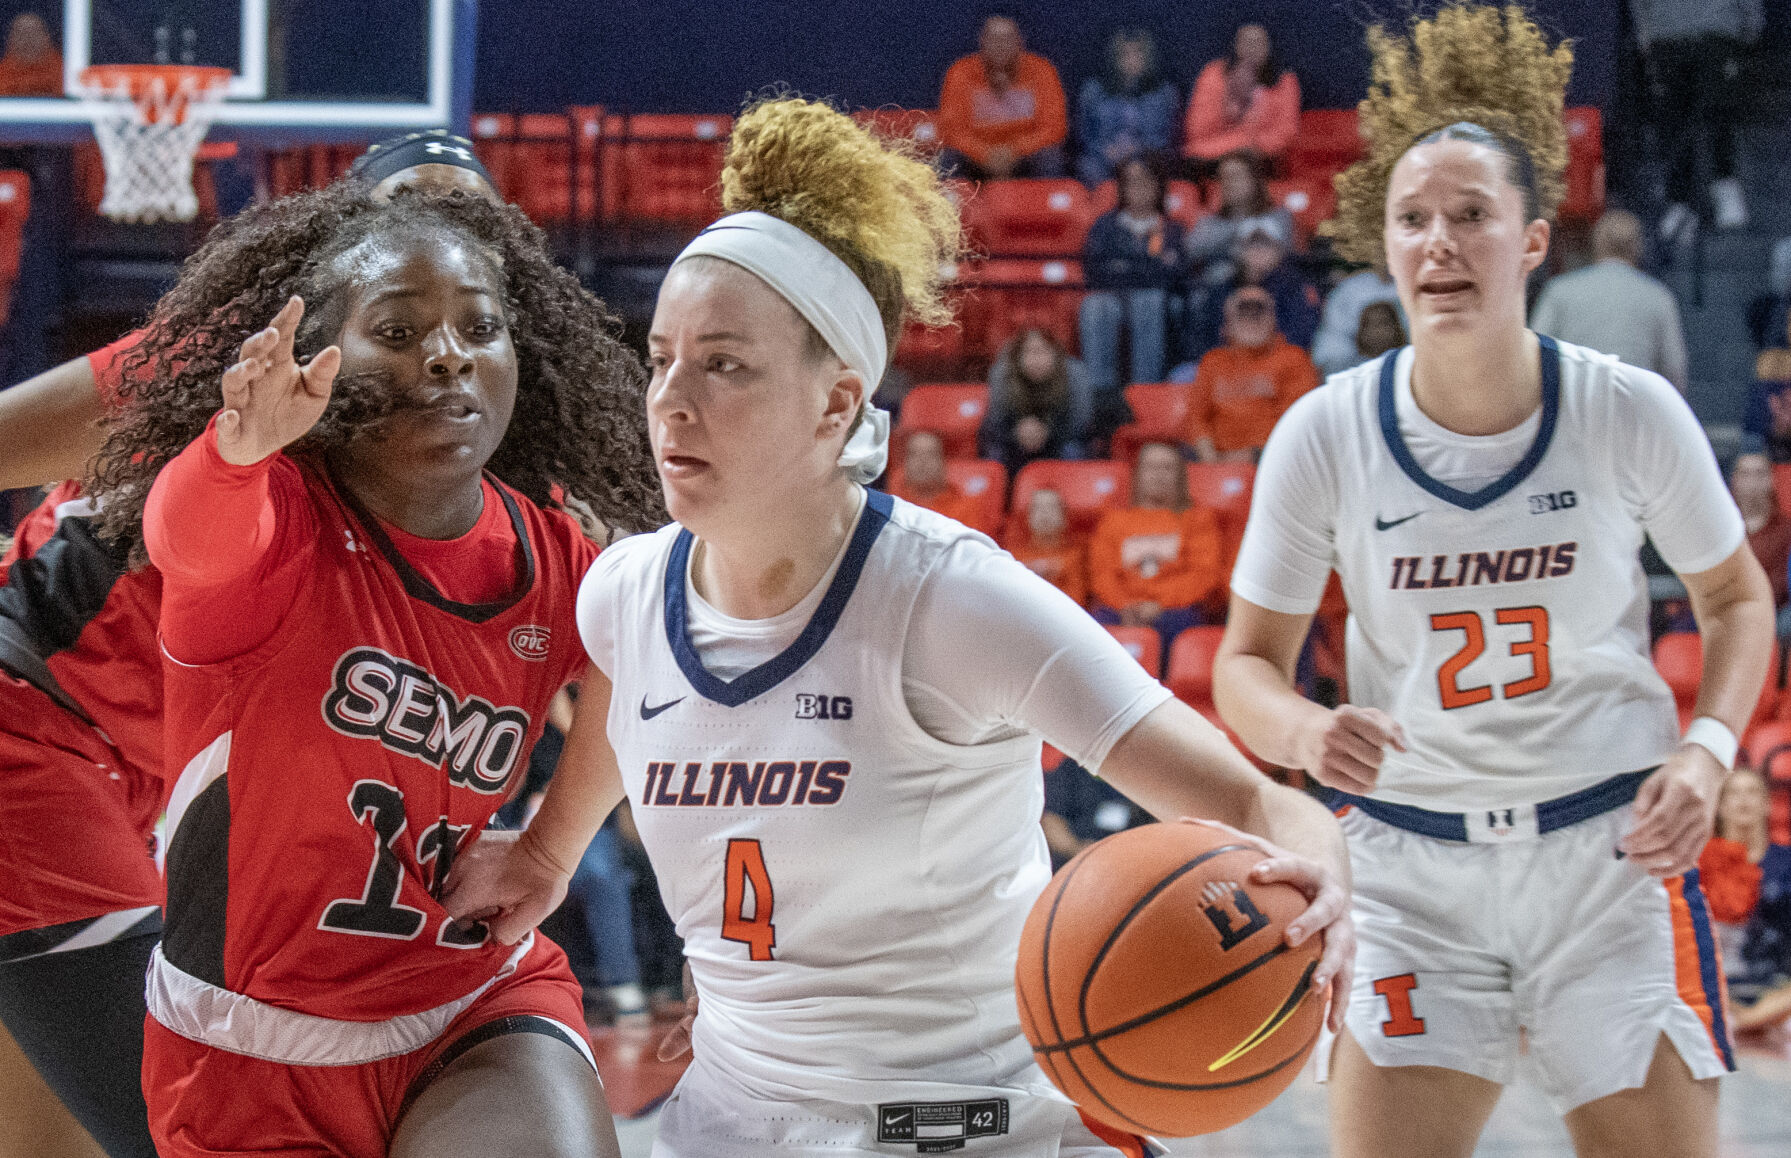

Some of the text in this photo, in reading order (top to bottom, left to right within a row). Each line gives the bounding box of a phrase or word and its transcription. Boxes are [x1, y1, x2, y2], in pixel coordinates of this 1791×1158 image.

[1390, 541, 1577, 589] ILLINOIS
[1429, 605, 1551, 711] 23
[321, 646, 531, 795] SEMO
[642, 760, 851, 806] ILLINOIS
[720, 838, 776, 961] 4
[1373, 972, 1425, 1037] I
[885, 1127, 912, 1135] TEAM
[972, 1111, 994, 1128] 42
